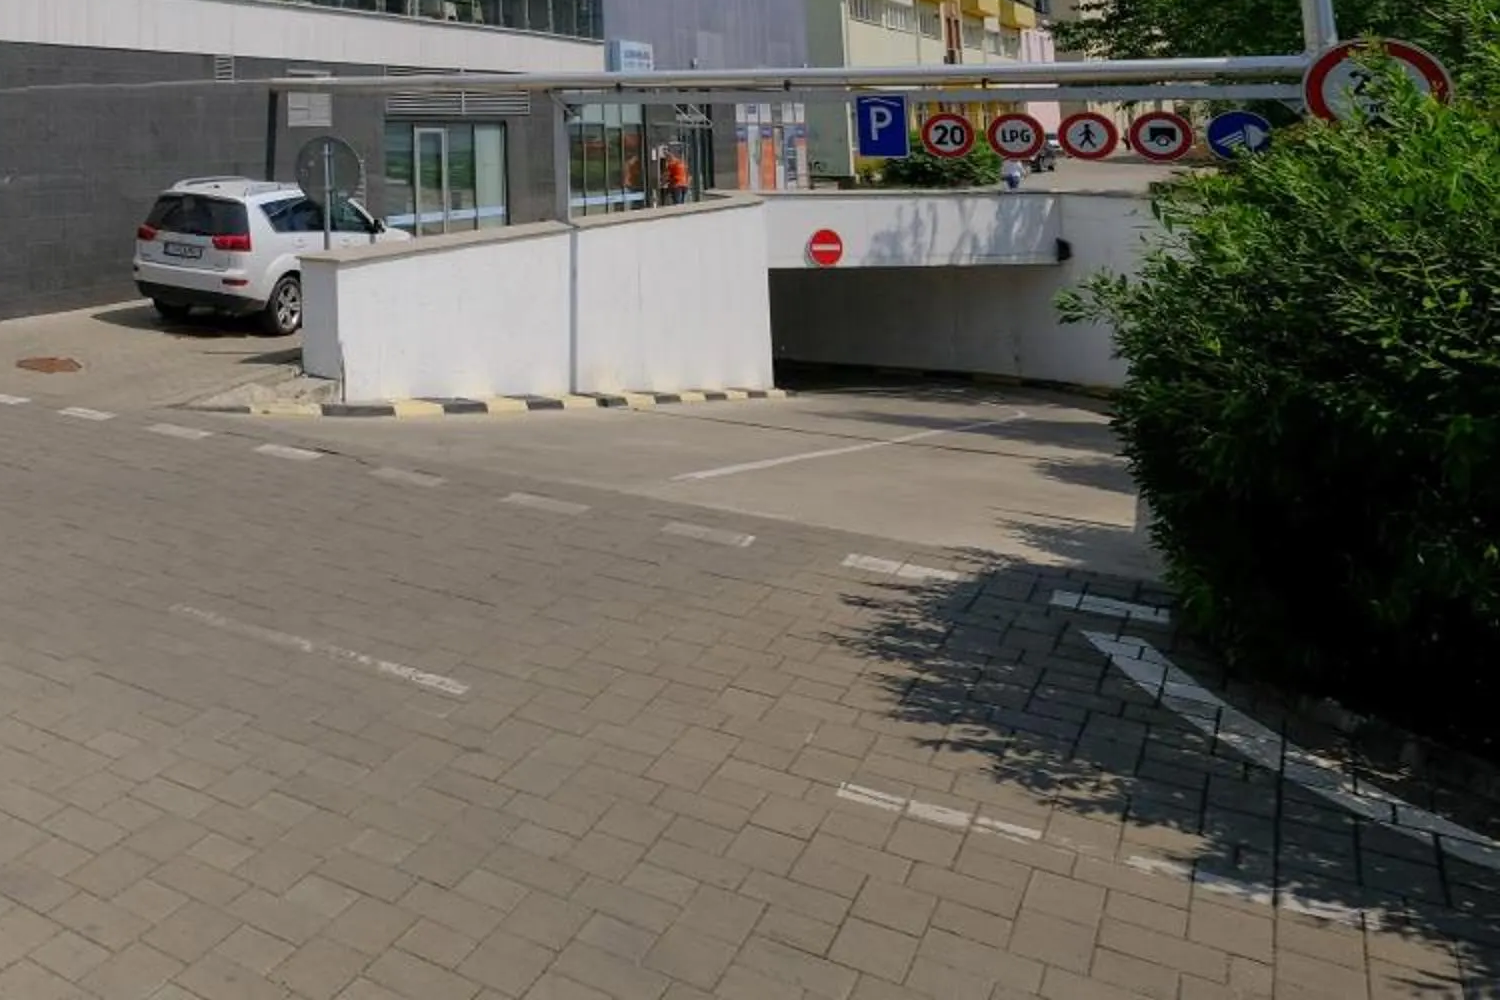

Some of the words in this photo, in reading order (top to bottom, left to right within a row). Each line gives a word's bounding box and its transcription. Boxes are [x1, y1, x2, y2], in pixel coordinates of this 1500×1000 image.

[869, 105, 893, 141] P
[934, 124, 965, 146] 20
[1001, 128, 1031, 143] LPG
